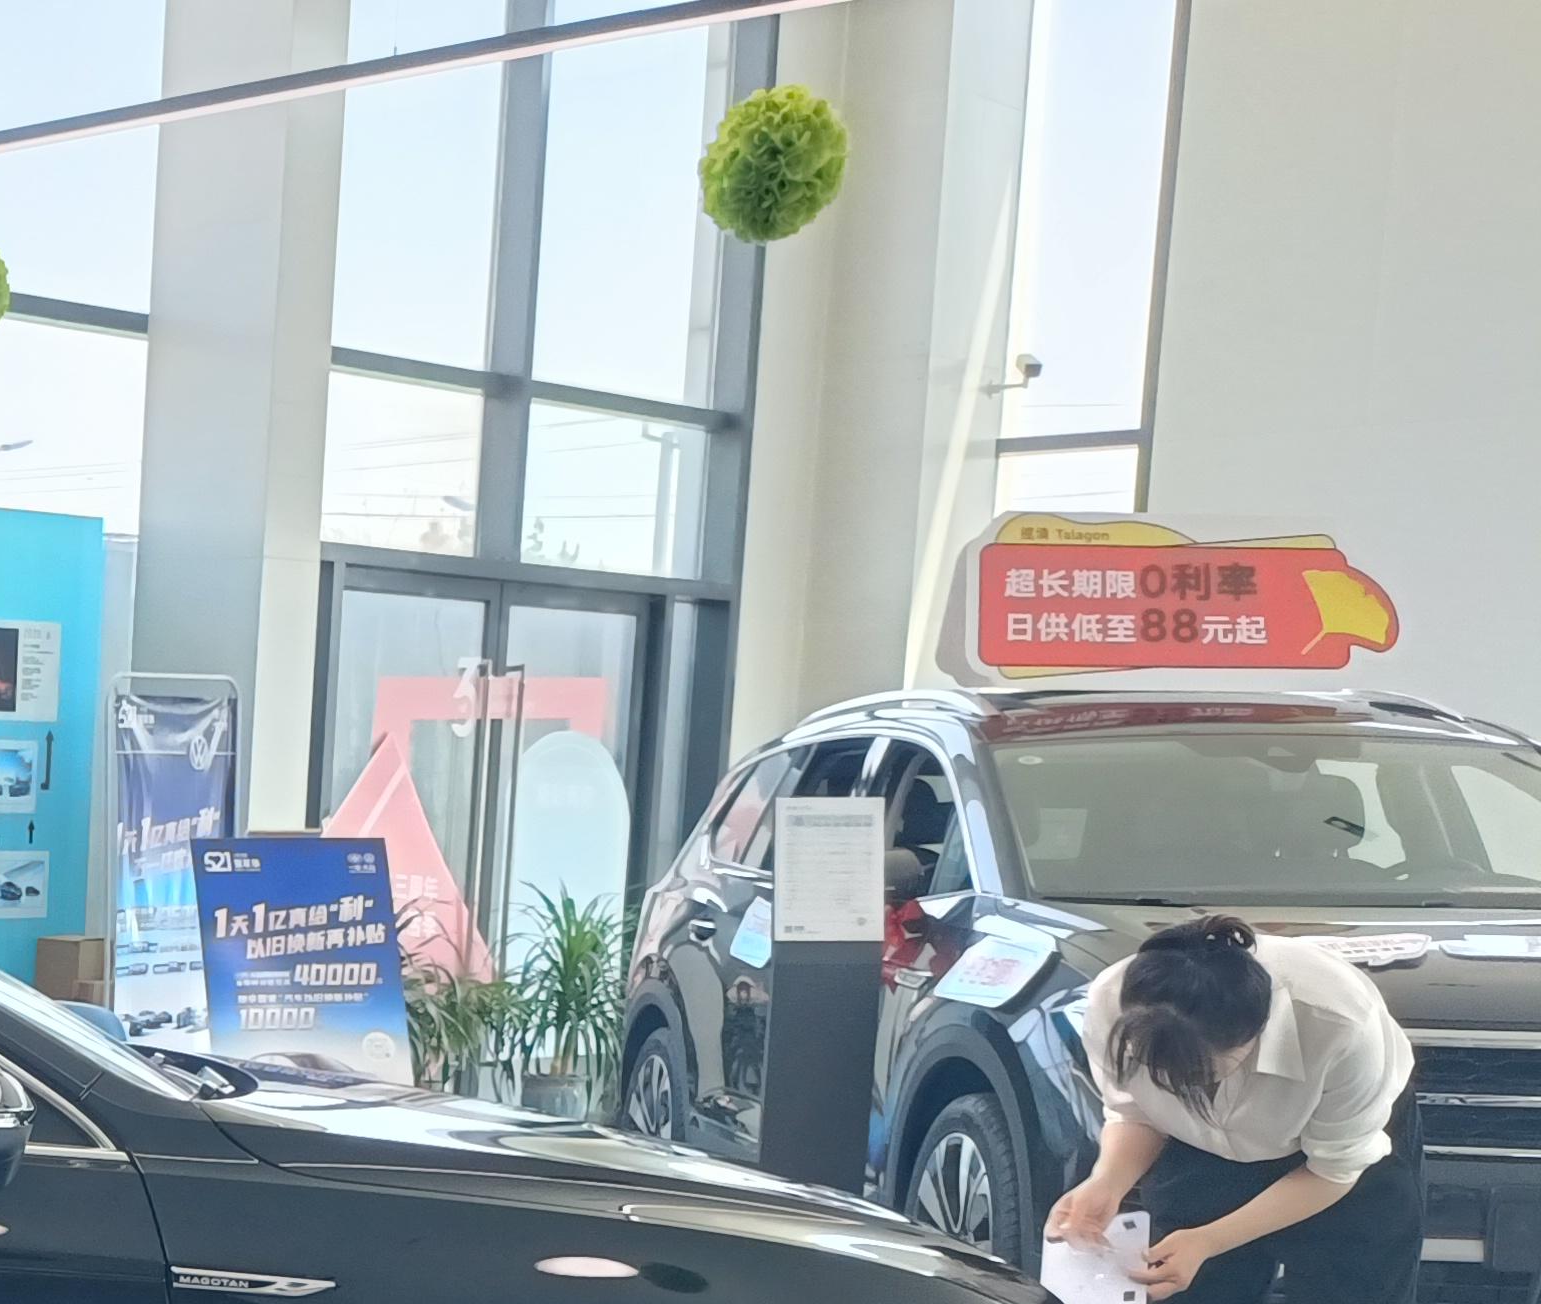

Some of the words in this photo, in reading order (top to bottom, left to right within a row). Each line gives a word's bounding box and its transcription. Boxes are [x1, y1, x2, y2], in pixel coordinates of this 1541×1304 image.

[1006, 608, 1268, 645] 日供低至88元起
[240, 1007, 316, 1032] 10000
[178, 1274, 250, 1288] MAGOTAN
